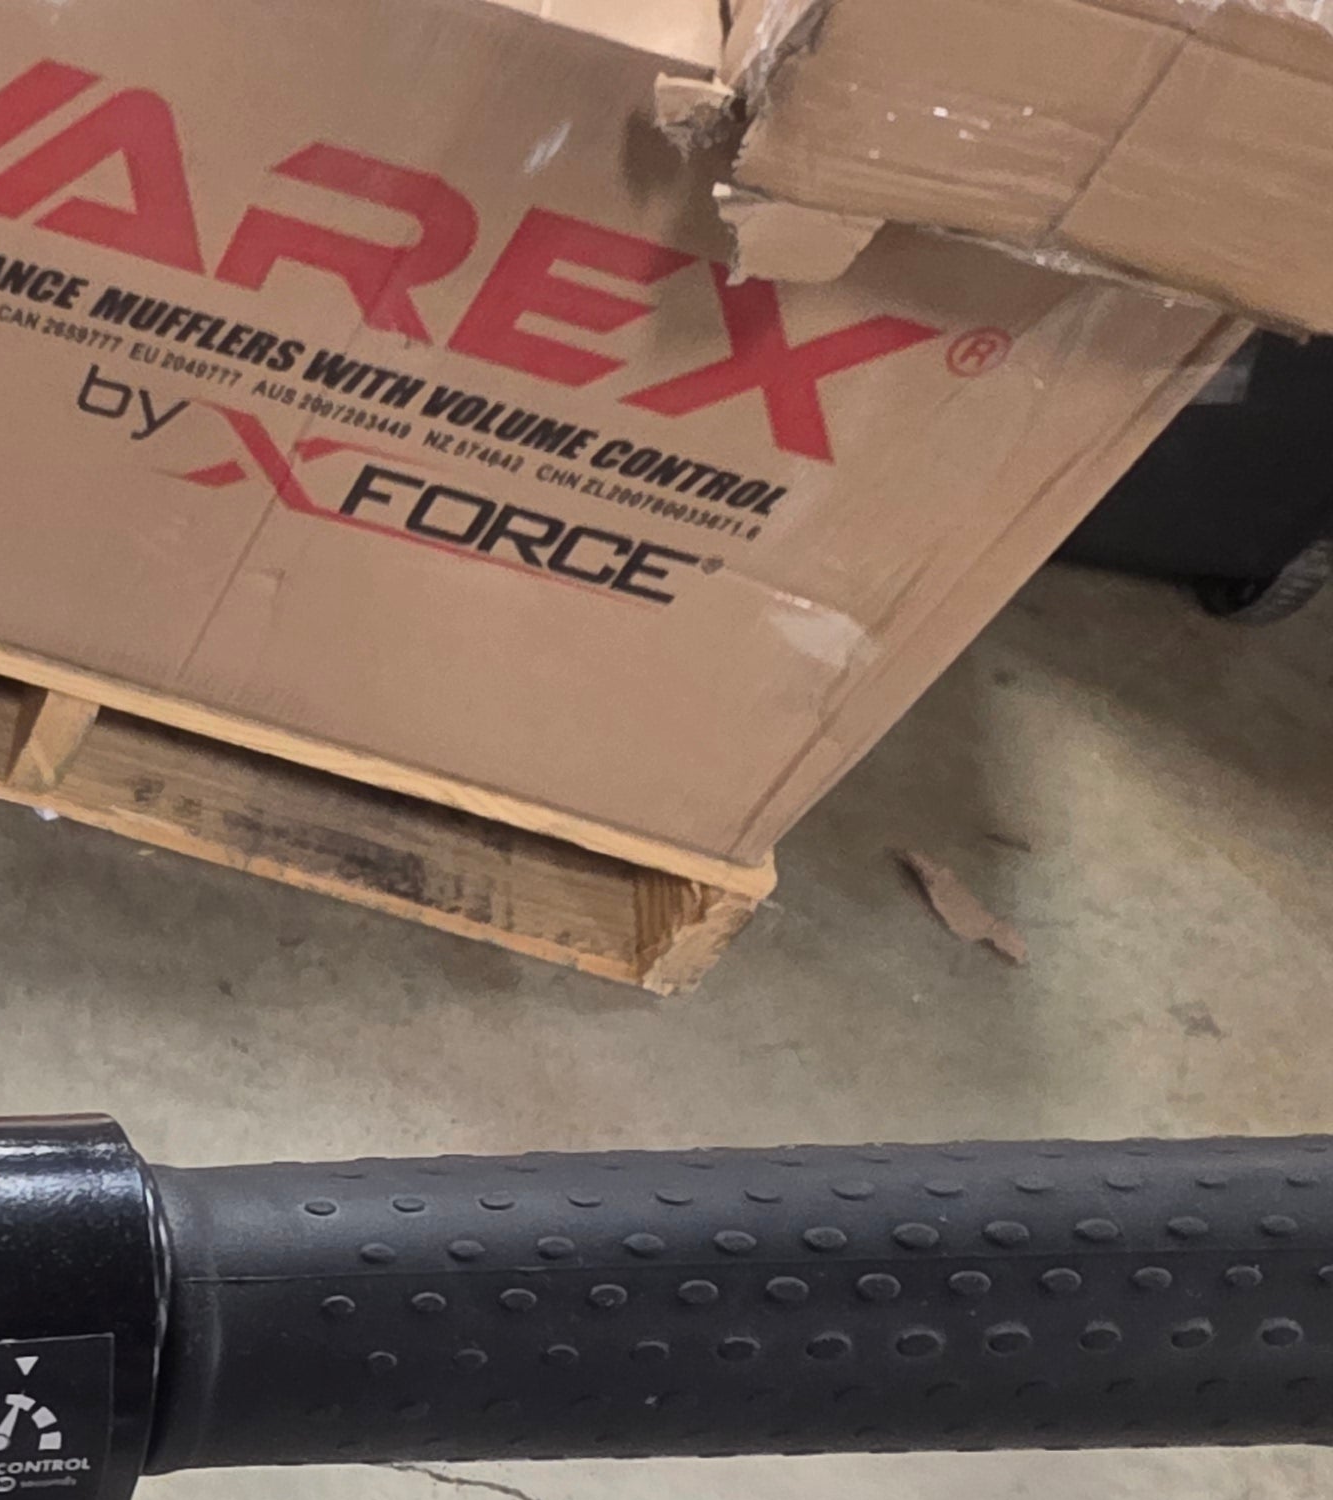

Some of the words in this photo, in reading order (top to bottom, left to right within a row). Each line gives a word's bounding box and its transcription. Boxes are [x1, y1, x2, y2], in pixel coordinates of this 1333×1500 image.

[76, 363, 191, 440] by
[88, 286, 306, 372] MUFFLERS
[301, 349, 427, 410] WITH
[420, 385, 600, 460] VOLUME
[590, 438, 788, 517] CONTROL
[128, 342, 161, 365] EU
[251, 379, 298, 406] AUS
